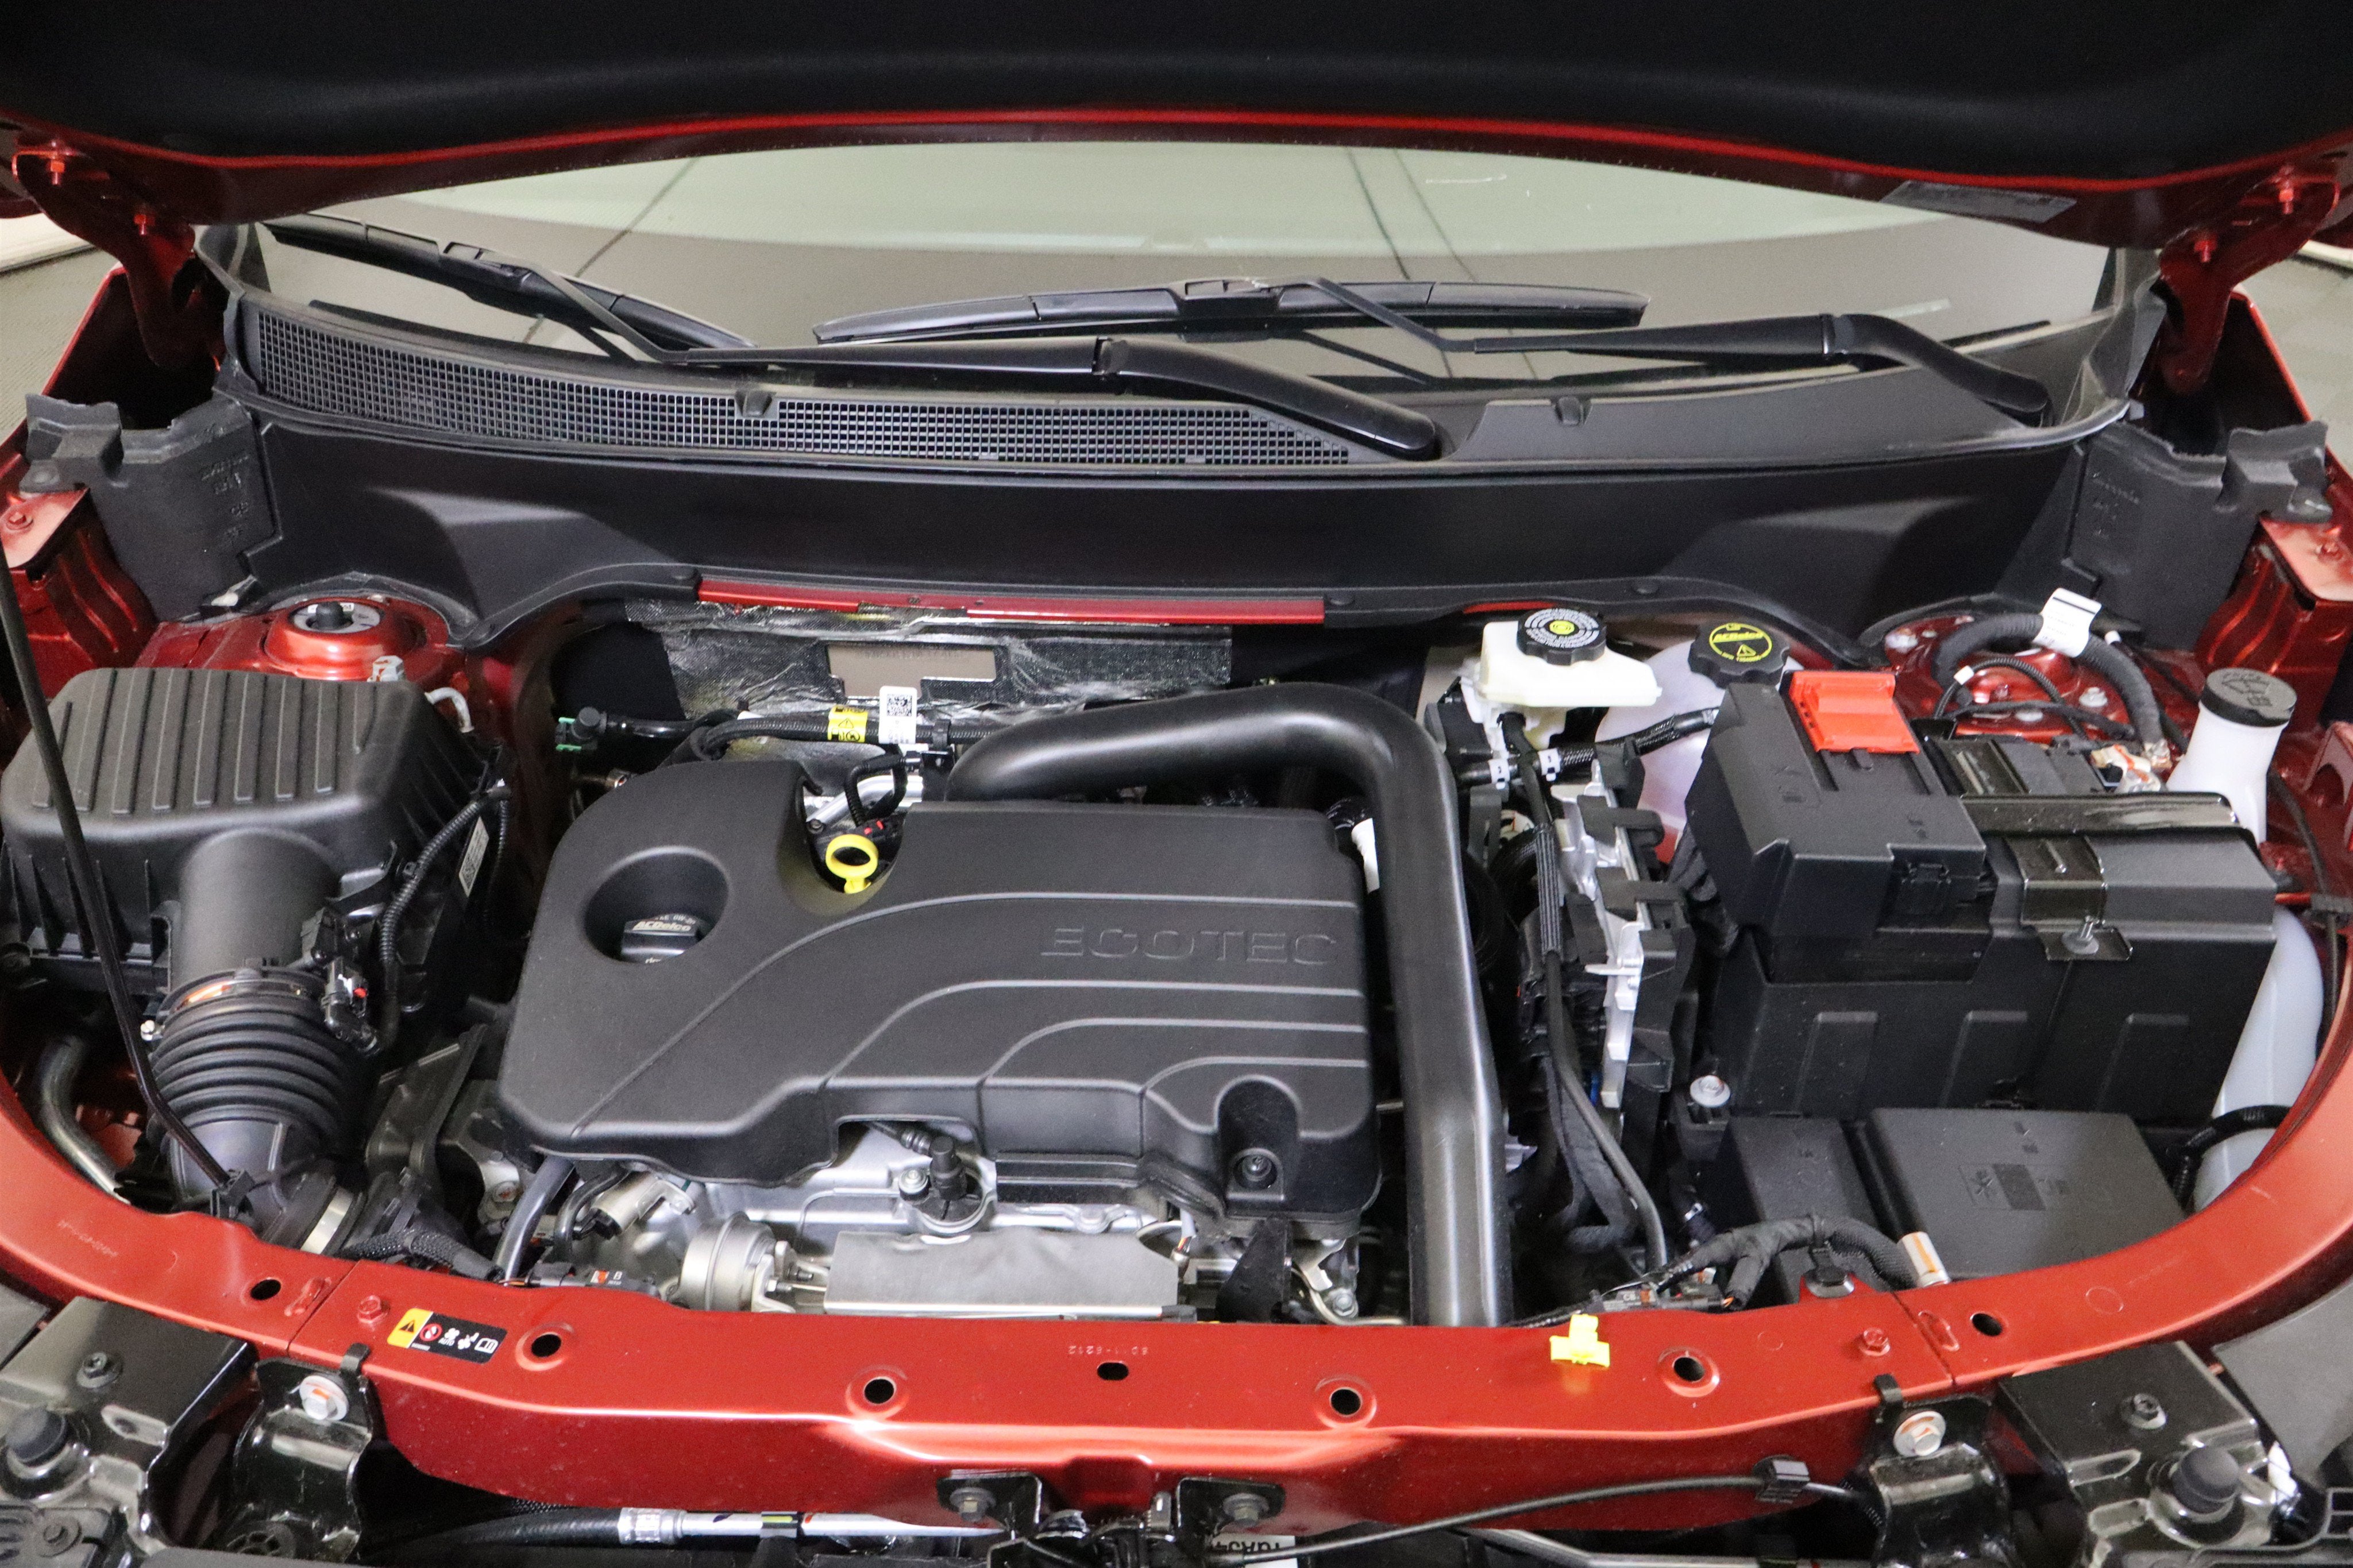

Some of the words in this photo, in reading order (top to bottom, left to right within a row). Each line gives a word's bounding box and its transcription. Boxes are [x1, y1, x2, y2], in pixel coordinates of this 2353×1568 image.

[632, 921, 691, 931] ACDelco
[1041, 927, 1337, 965] ECOTEC
[438, 1337, 456, 1346] AUTO
